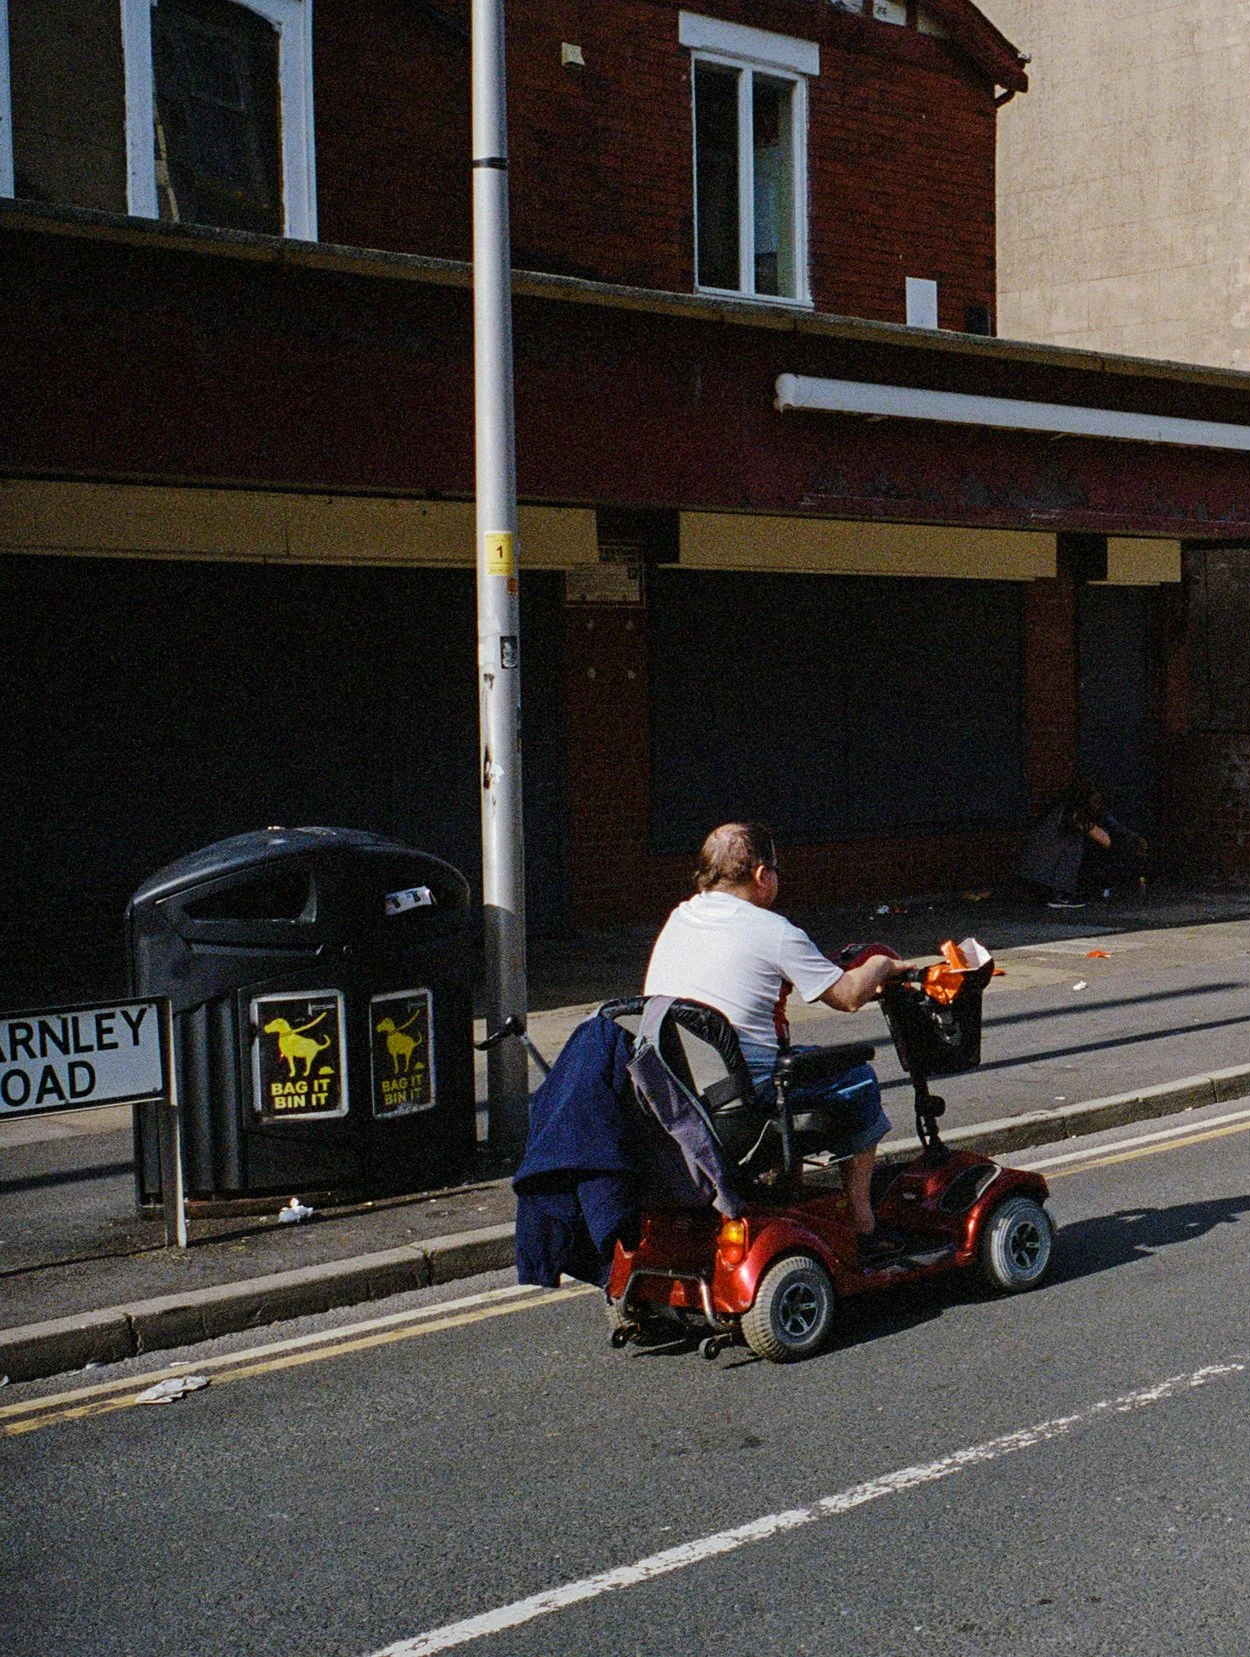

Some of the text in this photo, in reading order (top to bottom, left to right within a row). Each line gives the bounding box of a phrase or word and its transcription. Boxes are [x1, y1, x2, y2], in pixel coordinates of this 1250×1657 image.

[496, 545, 503, 558] 1
[0, 1008, 147, 1063] RNLEY
[0, 1060, 96, 1107] OAD
[271, 1079, 331, 1096] BAG IT
[382, 1074, 423, 1093] BAG IT
[274, 1093, 329, 1109] BIN IT
[384, 1088, 422, 1105] BIN IT
